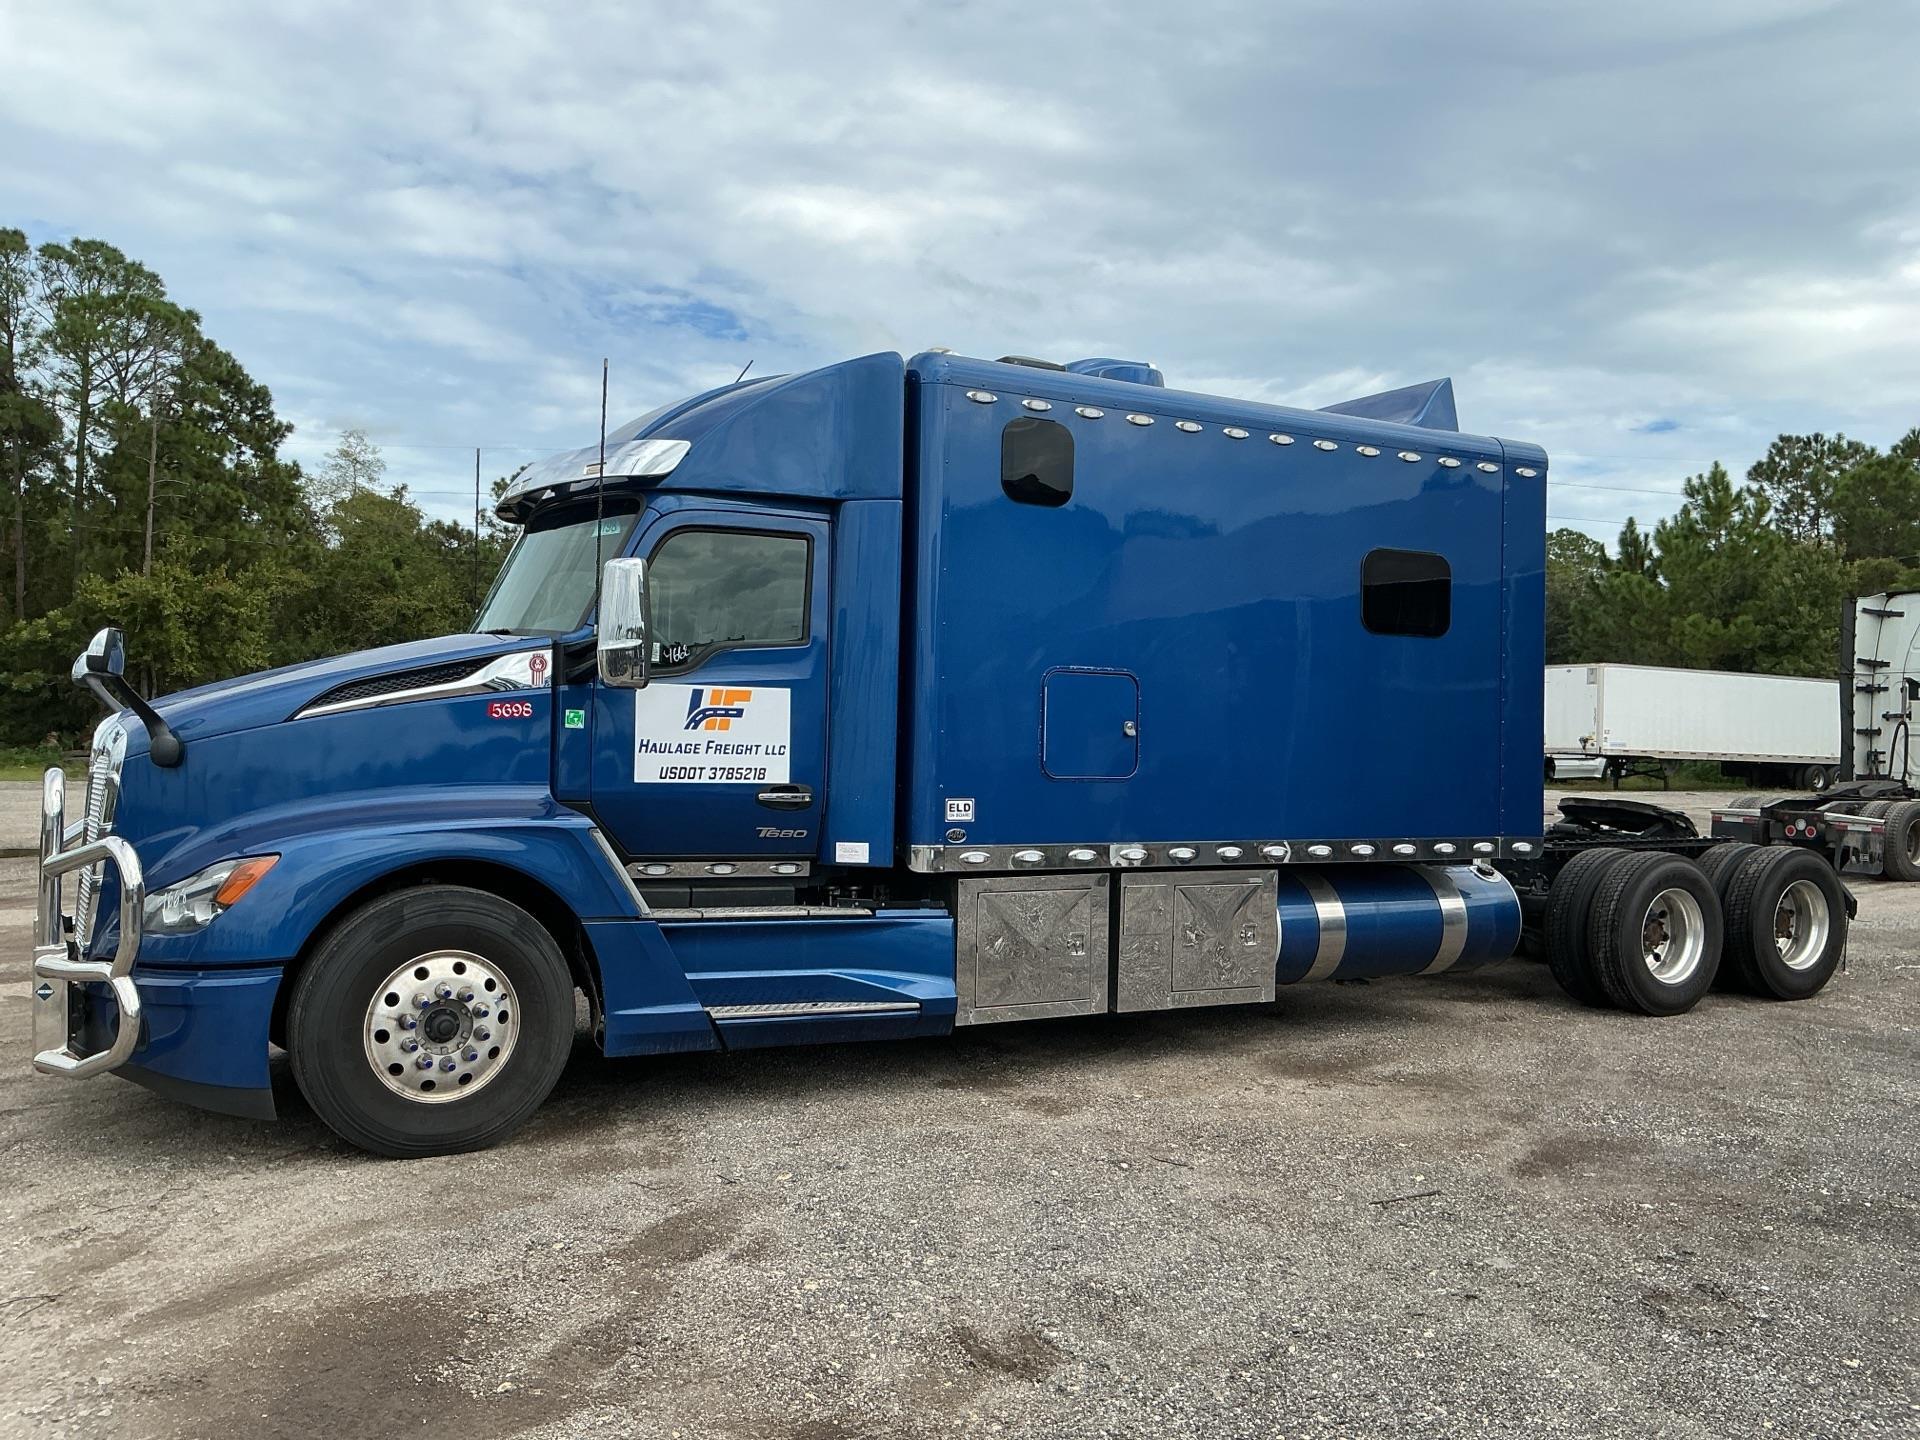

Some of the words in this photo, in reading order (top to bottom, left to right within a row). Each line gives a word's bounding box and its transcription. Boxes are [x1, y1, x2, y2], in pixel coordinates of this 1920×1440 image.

[492, 702, 533, 718] 5698
[638, 738, 701, 754] HAULAGE
[705, 740, 761, 755] FREIGHT
[764, 744, 786, 756] LLC
[659, 766, 705, 780] USDOT
[708, 767, 767, 780] 3785218
[948, 802, 971, 813] ELD
[755, 827, 808, 838] T680
